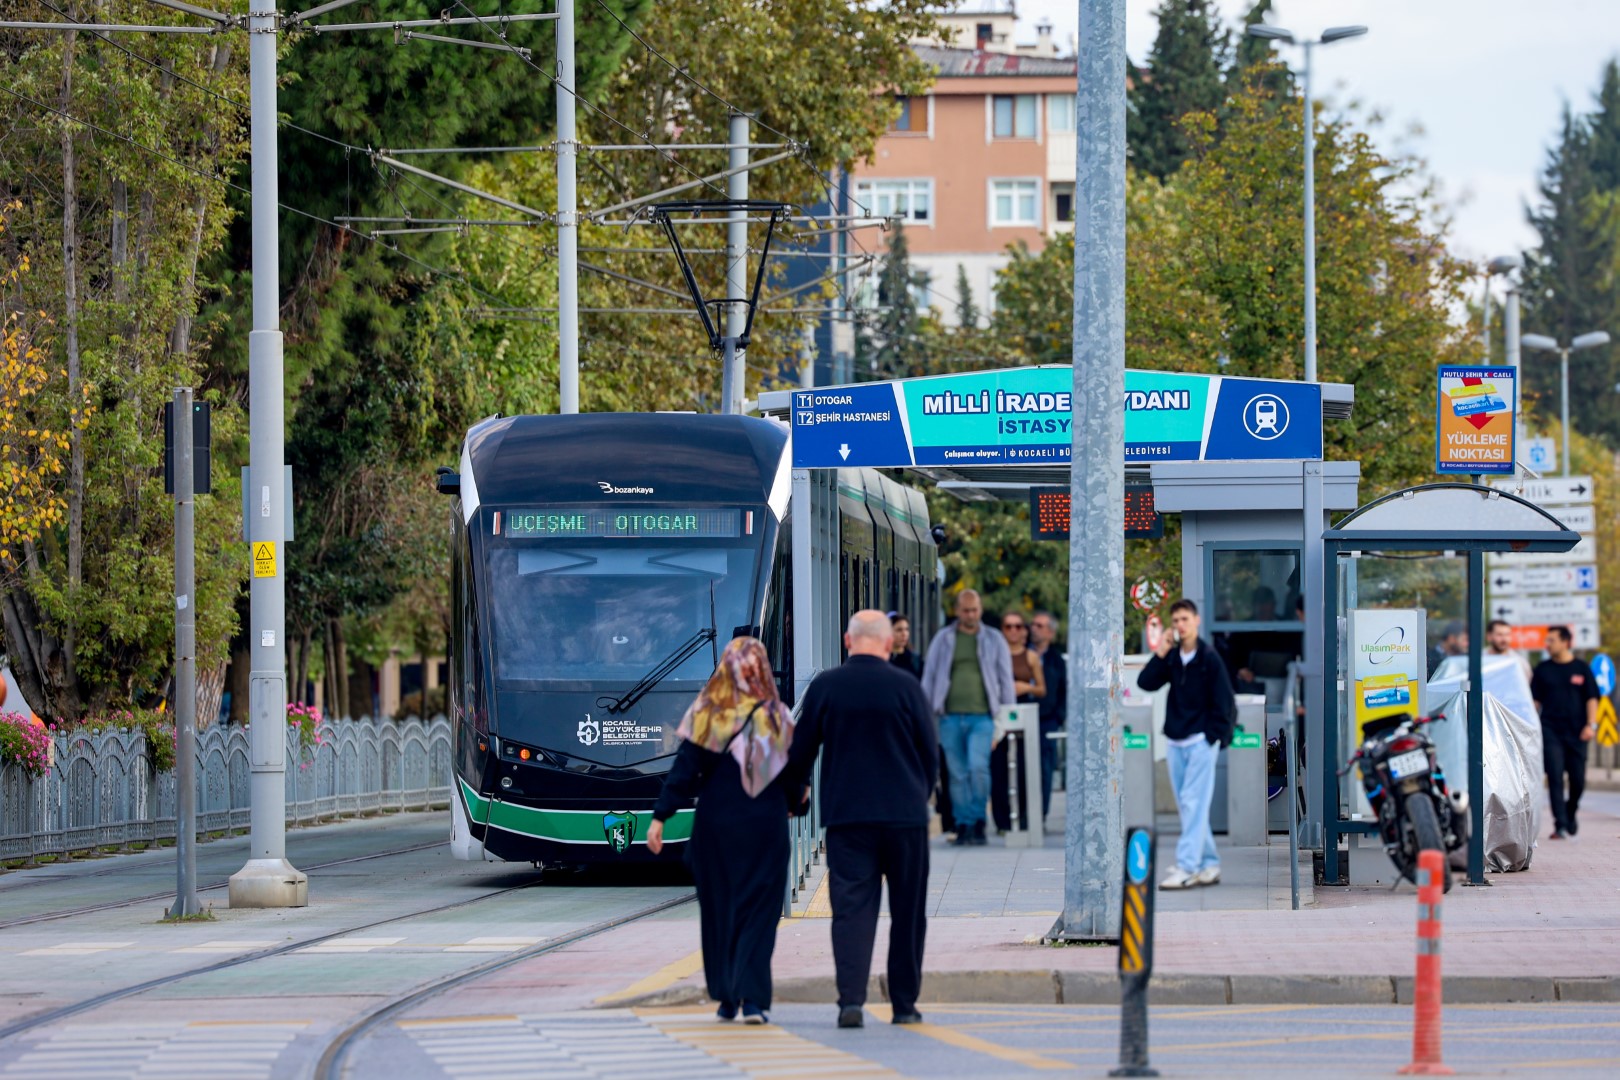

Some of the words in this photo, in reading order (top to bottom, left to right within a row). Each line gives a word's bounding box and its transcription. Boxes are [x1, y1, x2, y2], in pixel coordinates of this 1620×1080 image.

[799, 395, 812, 407] T1
[815, 396, 852, 405] OTOGAR
[924, 391, 989, 414] MİLLİ
[997, 391, 1071, 412] İRADE
[798, 412, 813, 424] T2
[815, 412, 841, 424] ŞEHİR
[843, 411, 890, 422] HASTANESİ
[1446, 432, 1507, 445] YÜKLEME
[1018, 448, 1055, 457] KOCAELİ
[1125, 447, 1171, 455] ELEDİYESİ
[1449, 448, 1505, 460] NOKTASI
[614, 486, 654, 495] bozankaya
[511, 515, 587, 532] UÇEŞME
[615, 515, 697, 530] OTOGAR
